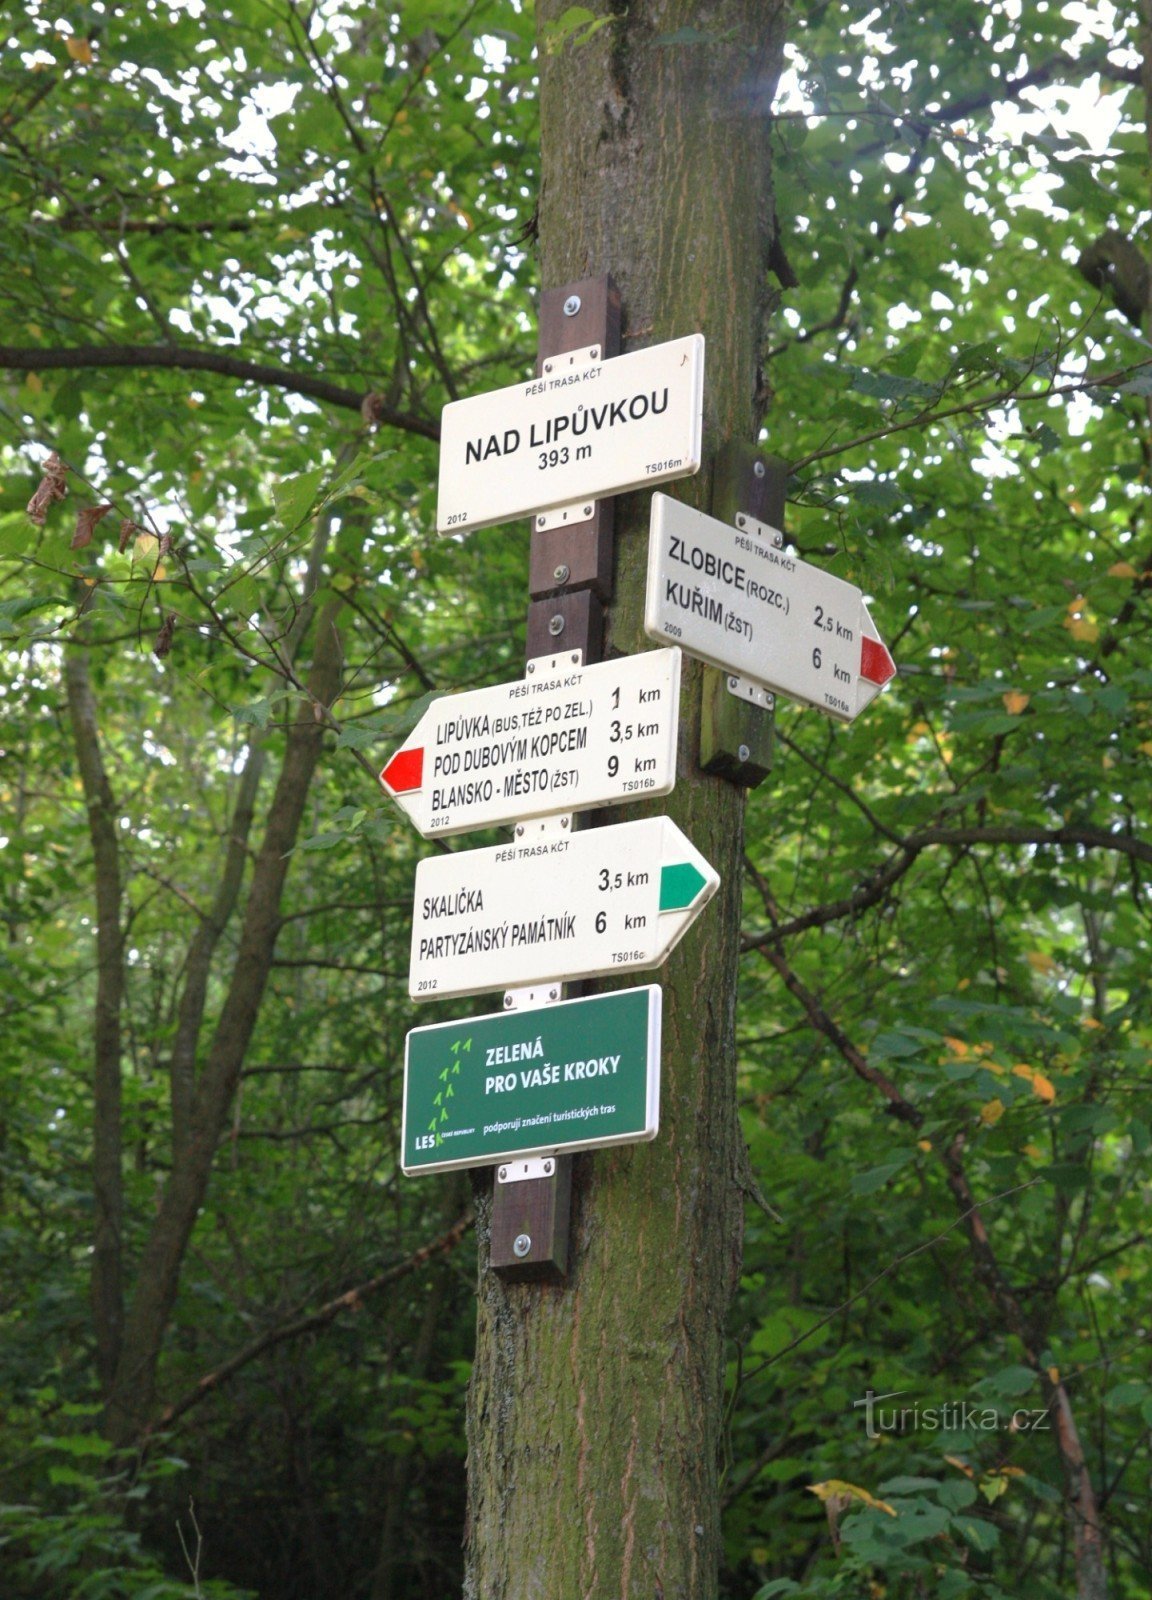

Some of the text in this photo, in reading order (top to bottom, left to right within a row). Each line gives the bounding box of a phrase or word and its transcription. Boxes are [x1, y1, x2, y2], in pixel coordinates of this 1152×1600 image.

[526, 368, 602, 396] PĚŠÍ TRASA KČT
[465, 388, 669, 464] NAD LIPŮVKOU
[538, 445, 592, 470] 393 m
[645, 459, 682, 474] TS016m
[447, 512, 467, 525] 2012
[735, 536, 796, 573] PĚŠÍ TRASA KČT
[664, 622, 682, 637] 2009
[814, 606, 833, 632] 2,5
[836, 621, 853, 641] km
[812, 648, 821, 668] 6
[834, 664, 850, 683] km
[509, 675, 582, 699] PĚŠÍ TRASA KČT
[545, 706, 561, 722] PO
[564, 700, 593, 719] ZEL.)
[612, 687, 621, 710] 1
[639, 687, 661, 703] km
[824, 693, 849, 712] TS016a
[434, 720, 659, 777] POD DUBOVÝM KOPCEM 3,5 km
[432, 780, 492, 811] BLANSKO
[607, 755, 619, 777] 9
[635, 757, 656, 774] km
[622, 778, 655, 792] TS016b
[431, 816, 450, 828] 2012
[495, 841, 569, 863] PĚŠÍ TRASA KČT
[422, 868, 648, 920] SKALIČKA 3,5 km
[420, 911, 646, 961] PARTYZÁNSKÝ PAMÁTNÍK 6 km
[611, 950, 645, 963] TS016c
[418, 980, 437, 991] 2012
[486, 1036, 544, 1066] ZELENÁ
[485, 1055, 621, 1094] PRO VAŠE KROKY
[522, 1112, 552, 1127] značení
[553, 1106, 598, 1121] turistických
[600, 1105, 616, 1114] tras
